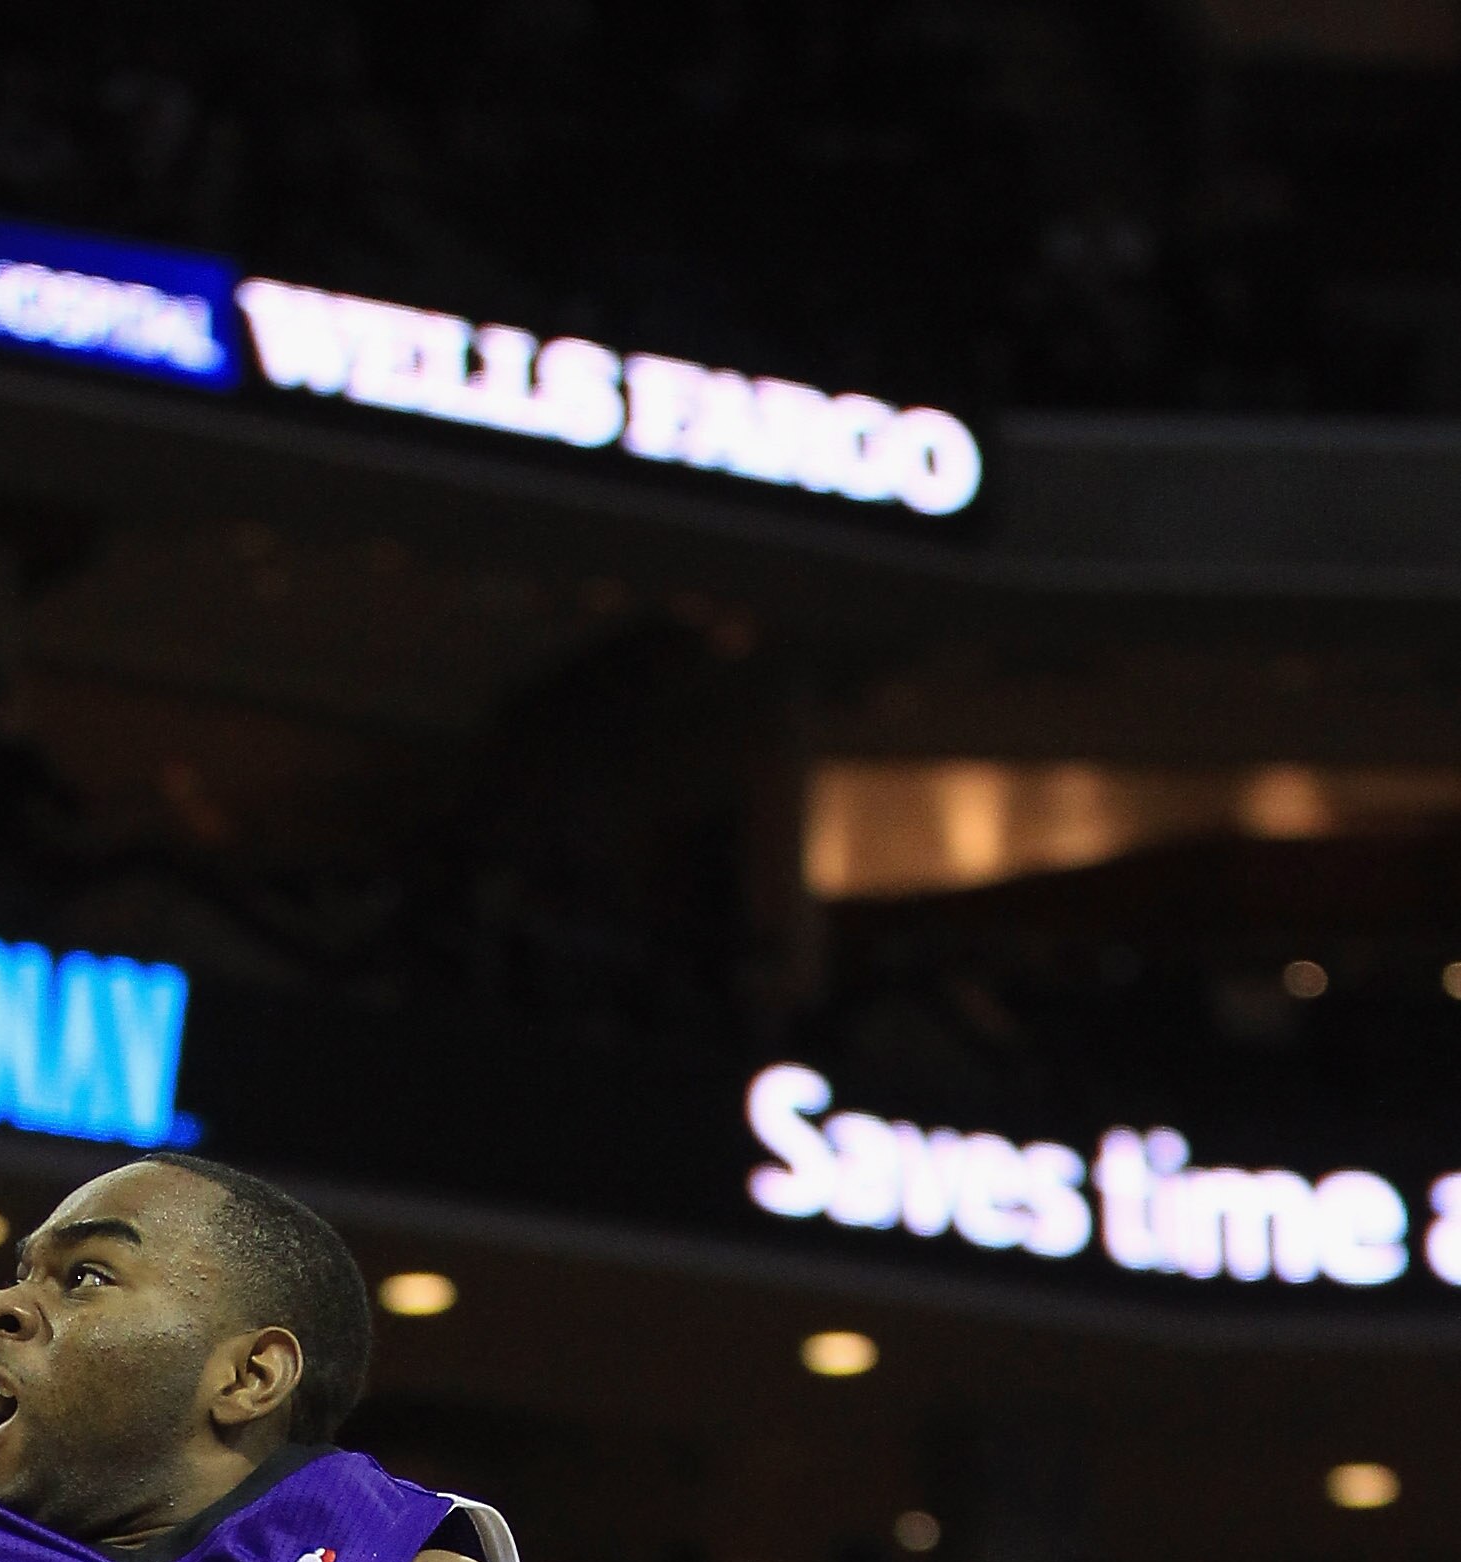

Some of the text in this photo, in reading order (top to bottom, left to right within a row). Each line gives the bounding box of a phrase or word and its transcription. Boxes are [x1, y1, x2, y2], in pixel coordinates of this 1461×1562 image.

[235, 277, 982, 515] WELLS FARGO
[746, 1061, 1092, 1259] Saves
[1094, 1125, 1408, 1286] time
